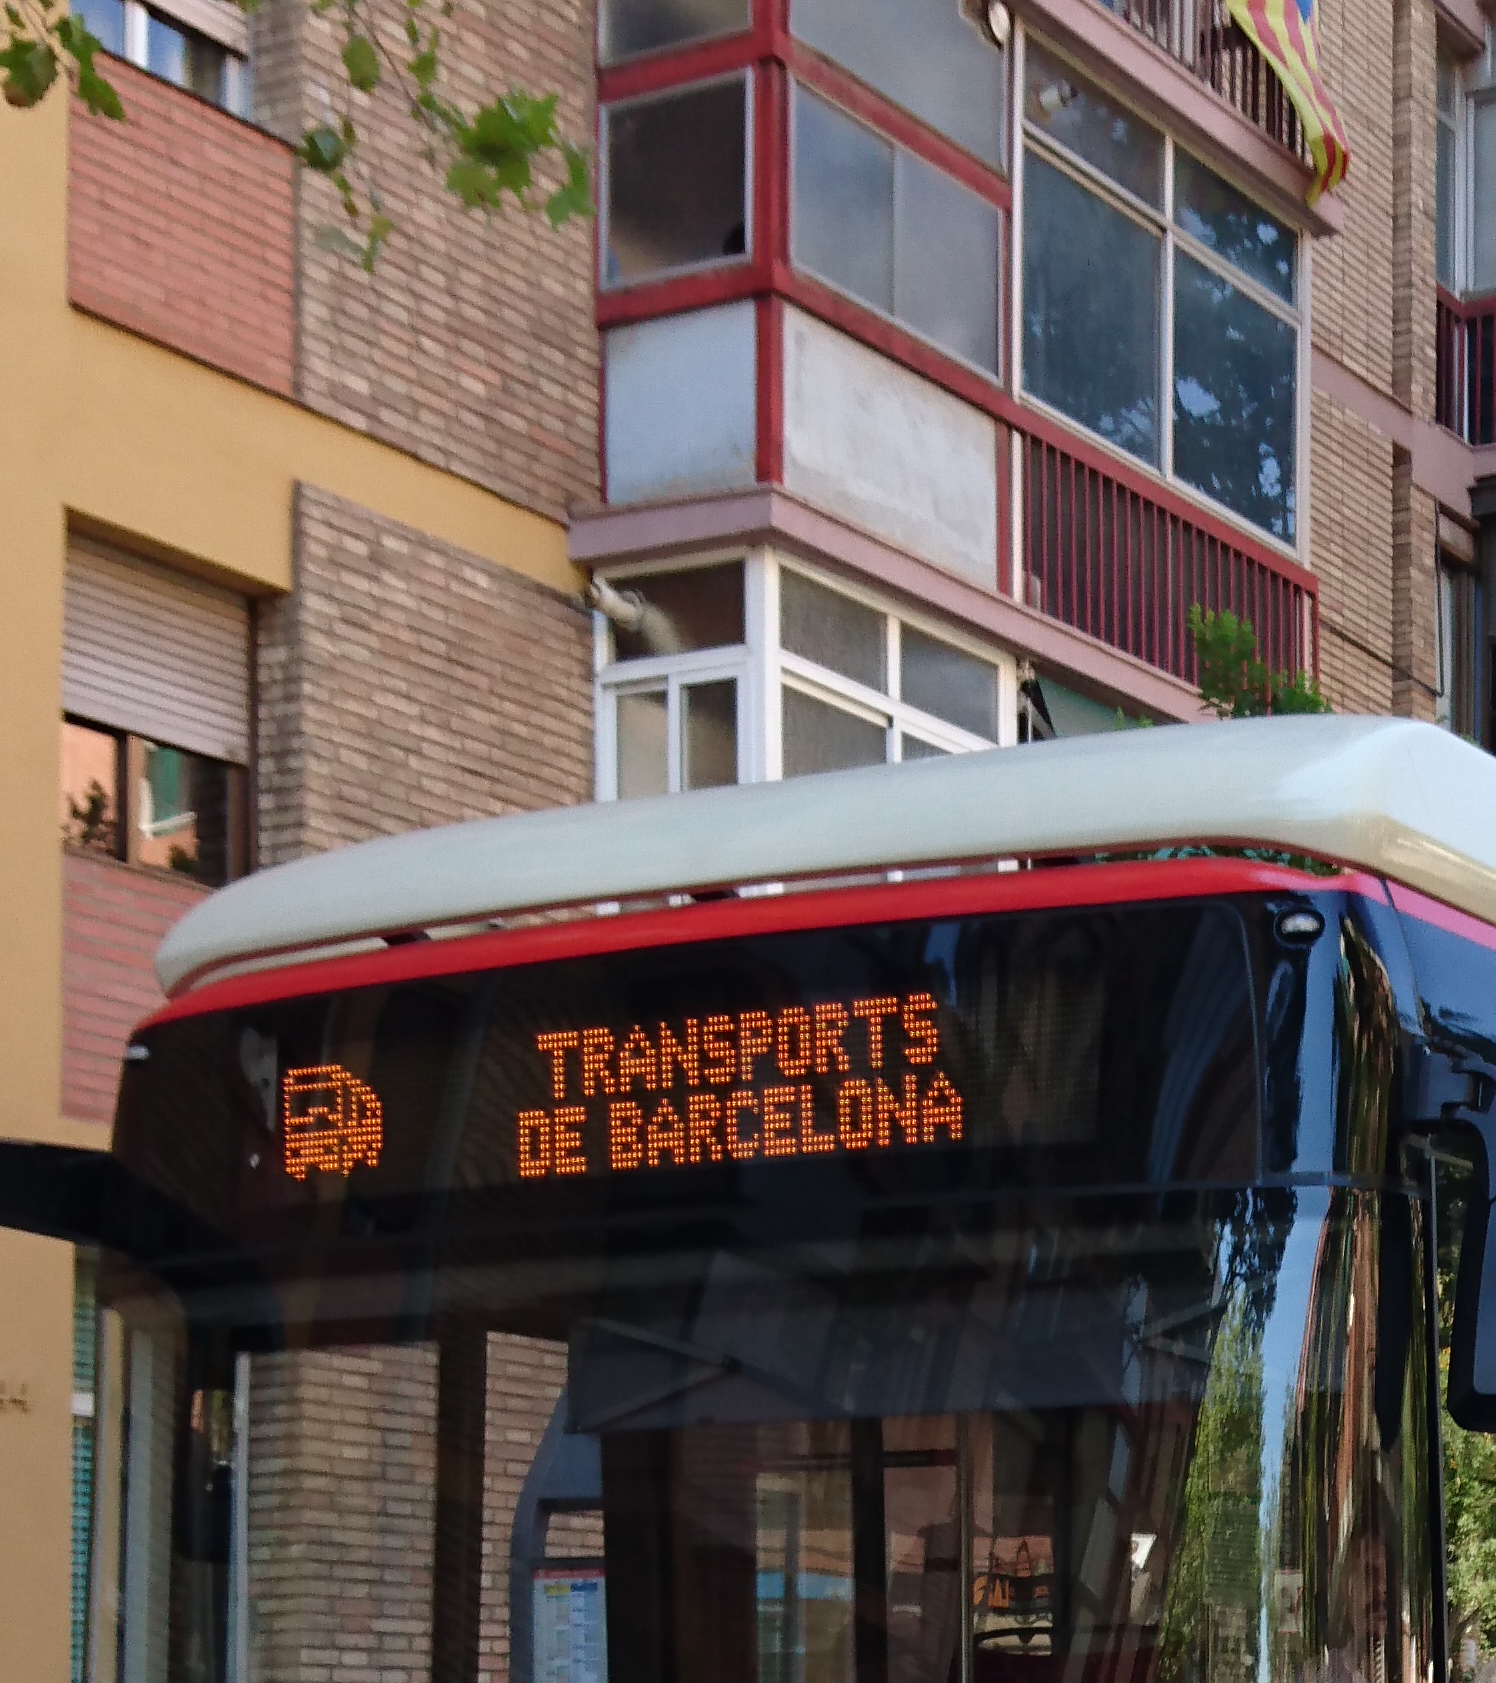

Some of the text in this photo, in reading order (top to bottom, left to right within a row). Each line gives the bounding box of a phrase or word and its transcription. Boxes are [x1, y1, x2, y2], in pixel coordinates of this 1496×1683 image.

[535, 992, 939, 1099] TRANSPORTS
[517, 1077, 965, 1178] DE BARCELONA
